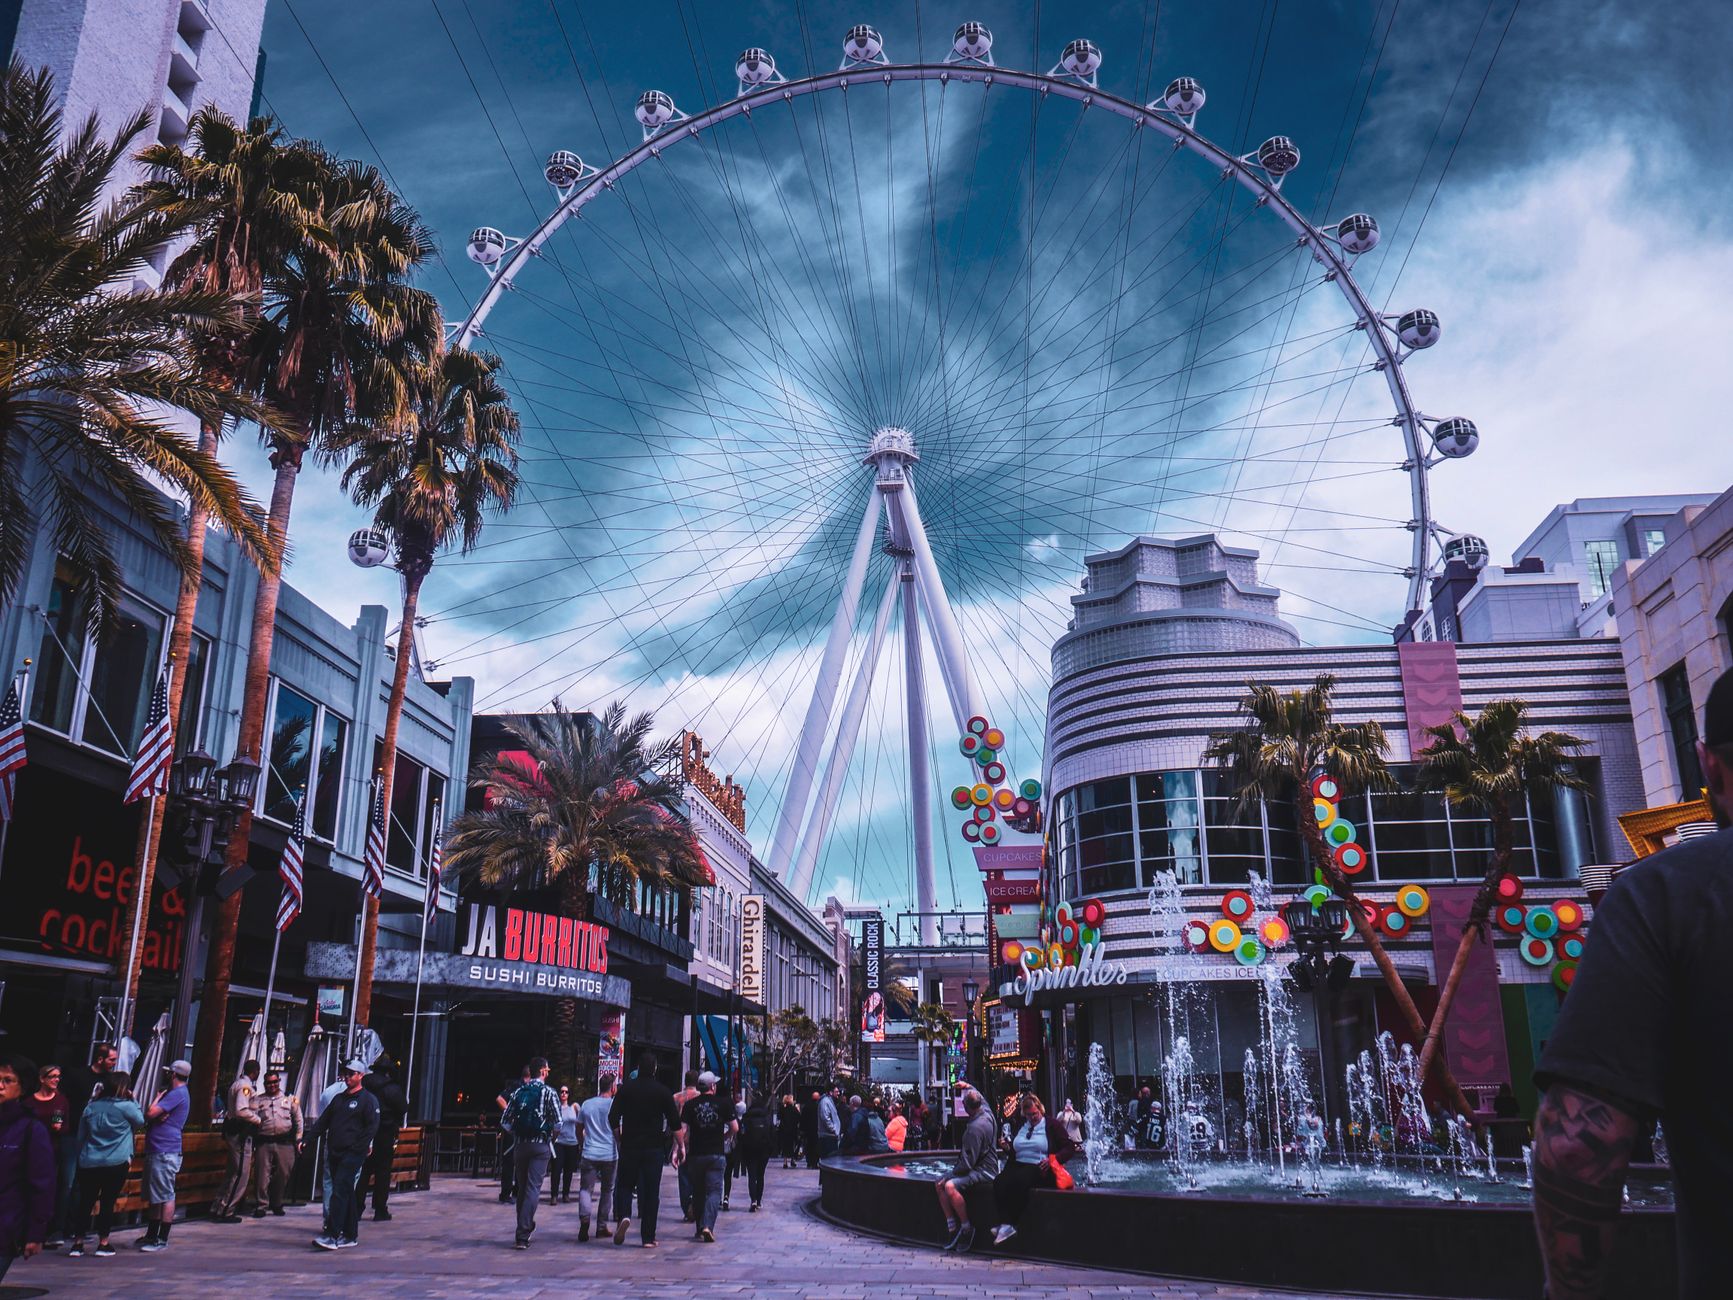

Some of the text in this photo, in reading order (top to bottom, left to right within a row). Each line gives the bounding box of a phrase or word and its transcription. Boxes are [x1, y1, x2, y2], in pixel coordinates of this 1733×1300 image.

[983, 852, 1042, 862] CUPCAKES
[990, 886, 1038, 896] ICE CREA
[461, 903, 610, 975] JA BURRITOS
[867, 922, 879, 989] CLASSIC ROCK
[469, 965, 602, 994] SUSHI BURRITOS
[1014, 941, 1128, 1007] Sprinkles
[1162, 967, 1231, 980] CUPCAKES
[1235, 967, 1254, 979] ICE
[1146, 1123, 1162, 1142] 16
